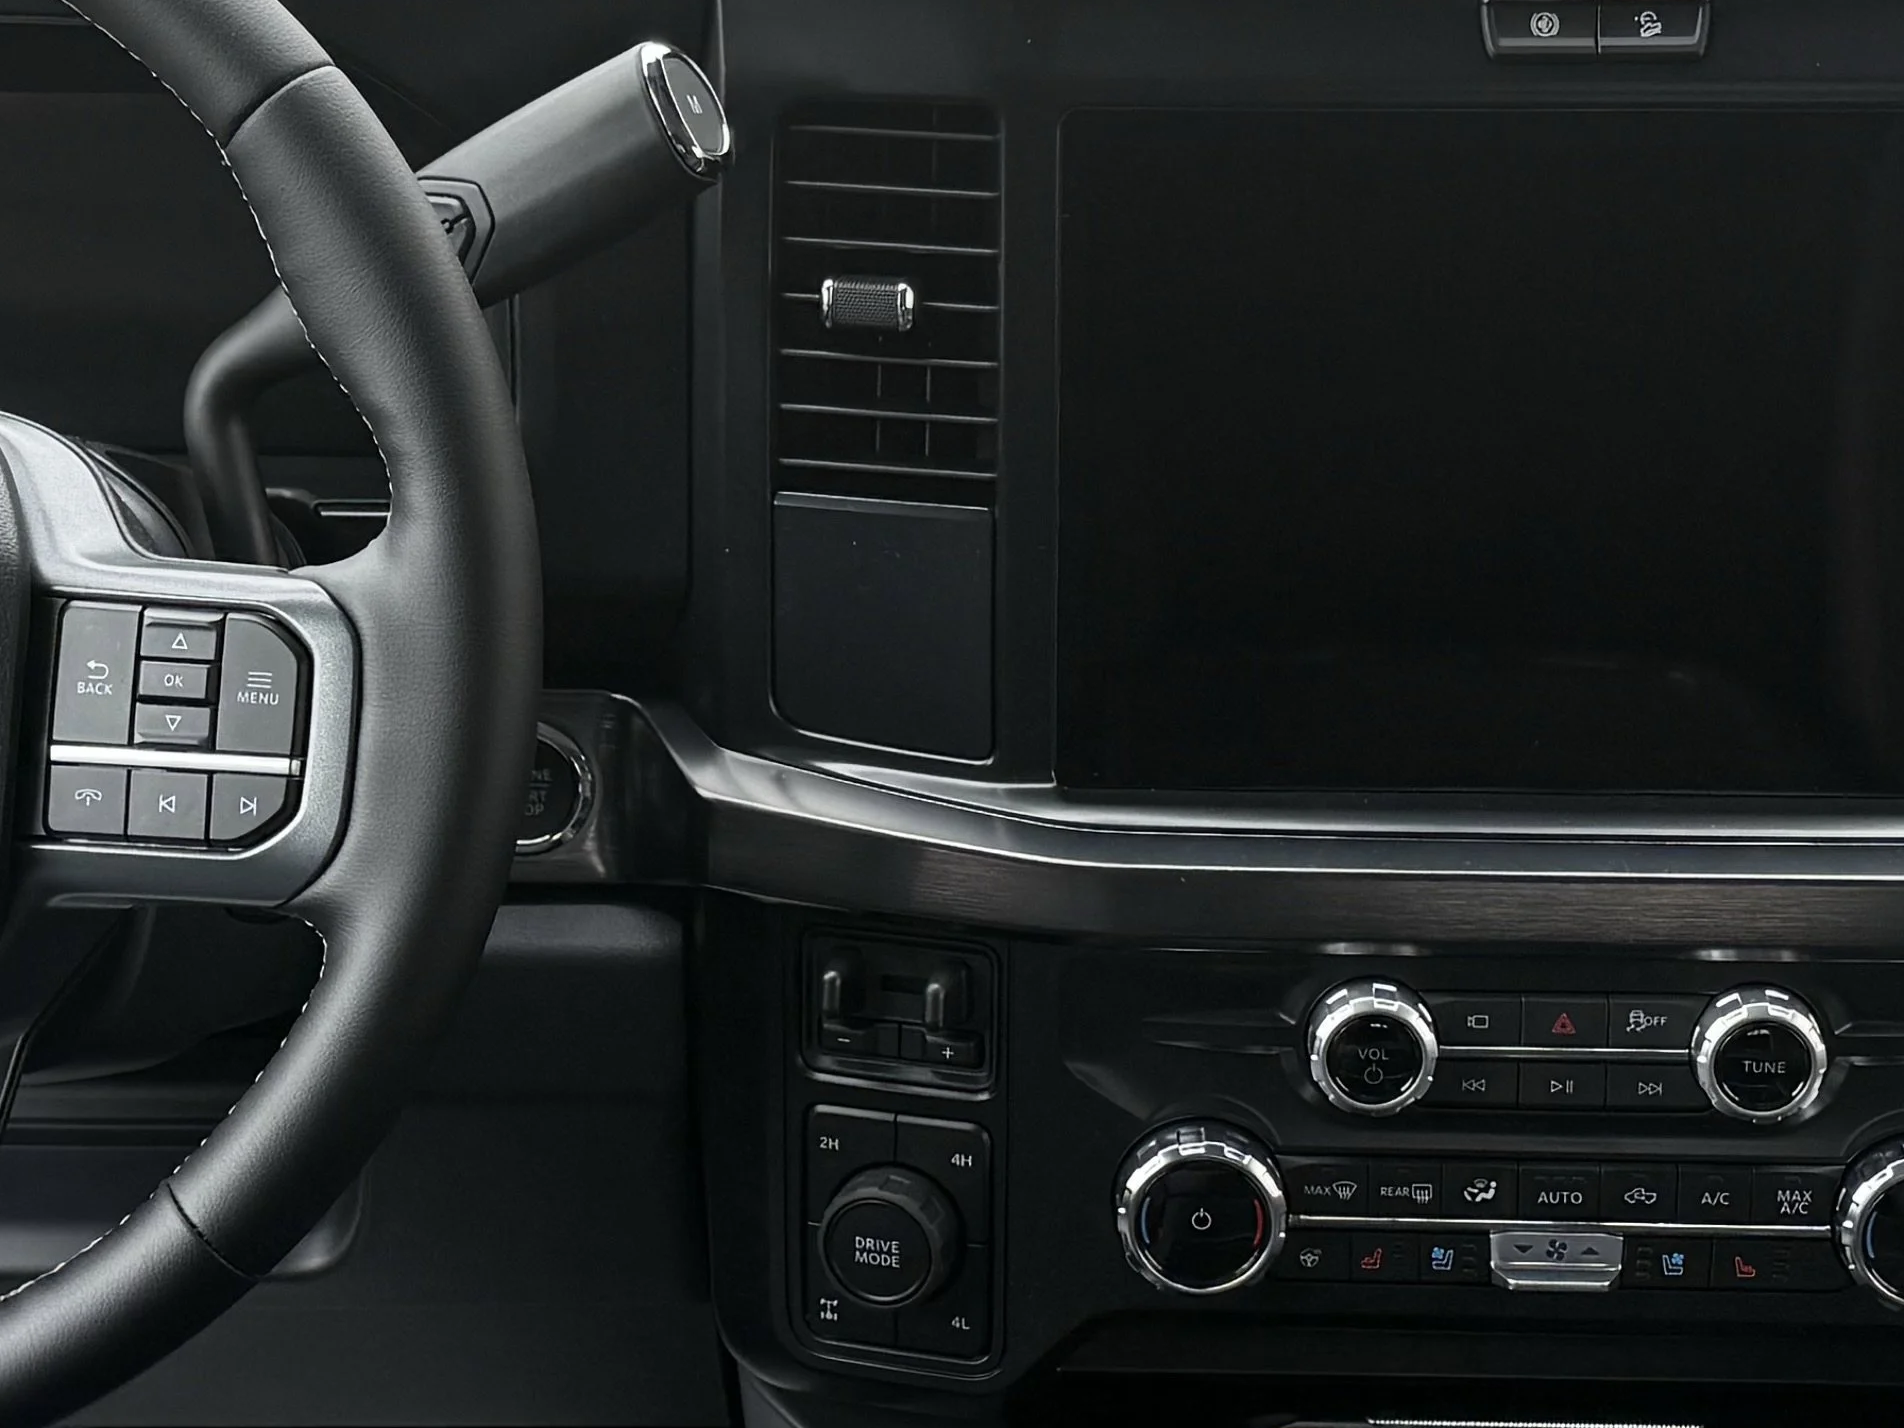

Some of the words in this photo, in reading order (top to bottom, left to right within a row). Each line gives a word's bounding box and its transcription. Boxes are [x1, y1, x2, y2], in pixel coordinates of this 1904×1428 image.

[164, 674, 184, 688] OK
[76, 682, 113, 696] BACK
[237, 692, 280, 706] MENU
[1643, 1013, 1668, 1028] OFF
[1357, 1047, 1389, 1061] VOL
[1742, 1060, 1787, 1074] TUNE
[819, 1136, 840, 1151] 2H
[950, 1153, 973, 1168] 4H
[1304, 1184, 1331, 1195] MAX
[1380, 1185, 1410, 1197] REAR
[1537, 1190, 1584, 1205] AUTO
[1701, 1190, 1730, 1206] A/C
[1777, 1190, 1813, 1204] MAX
[1780, 1201, 1809, 1215] A/C
[854, 1236, 900, 1254] DRIVE
[854, 1251, 900, 1269] MODE
[951, 1316, 971, 1331] 4L
